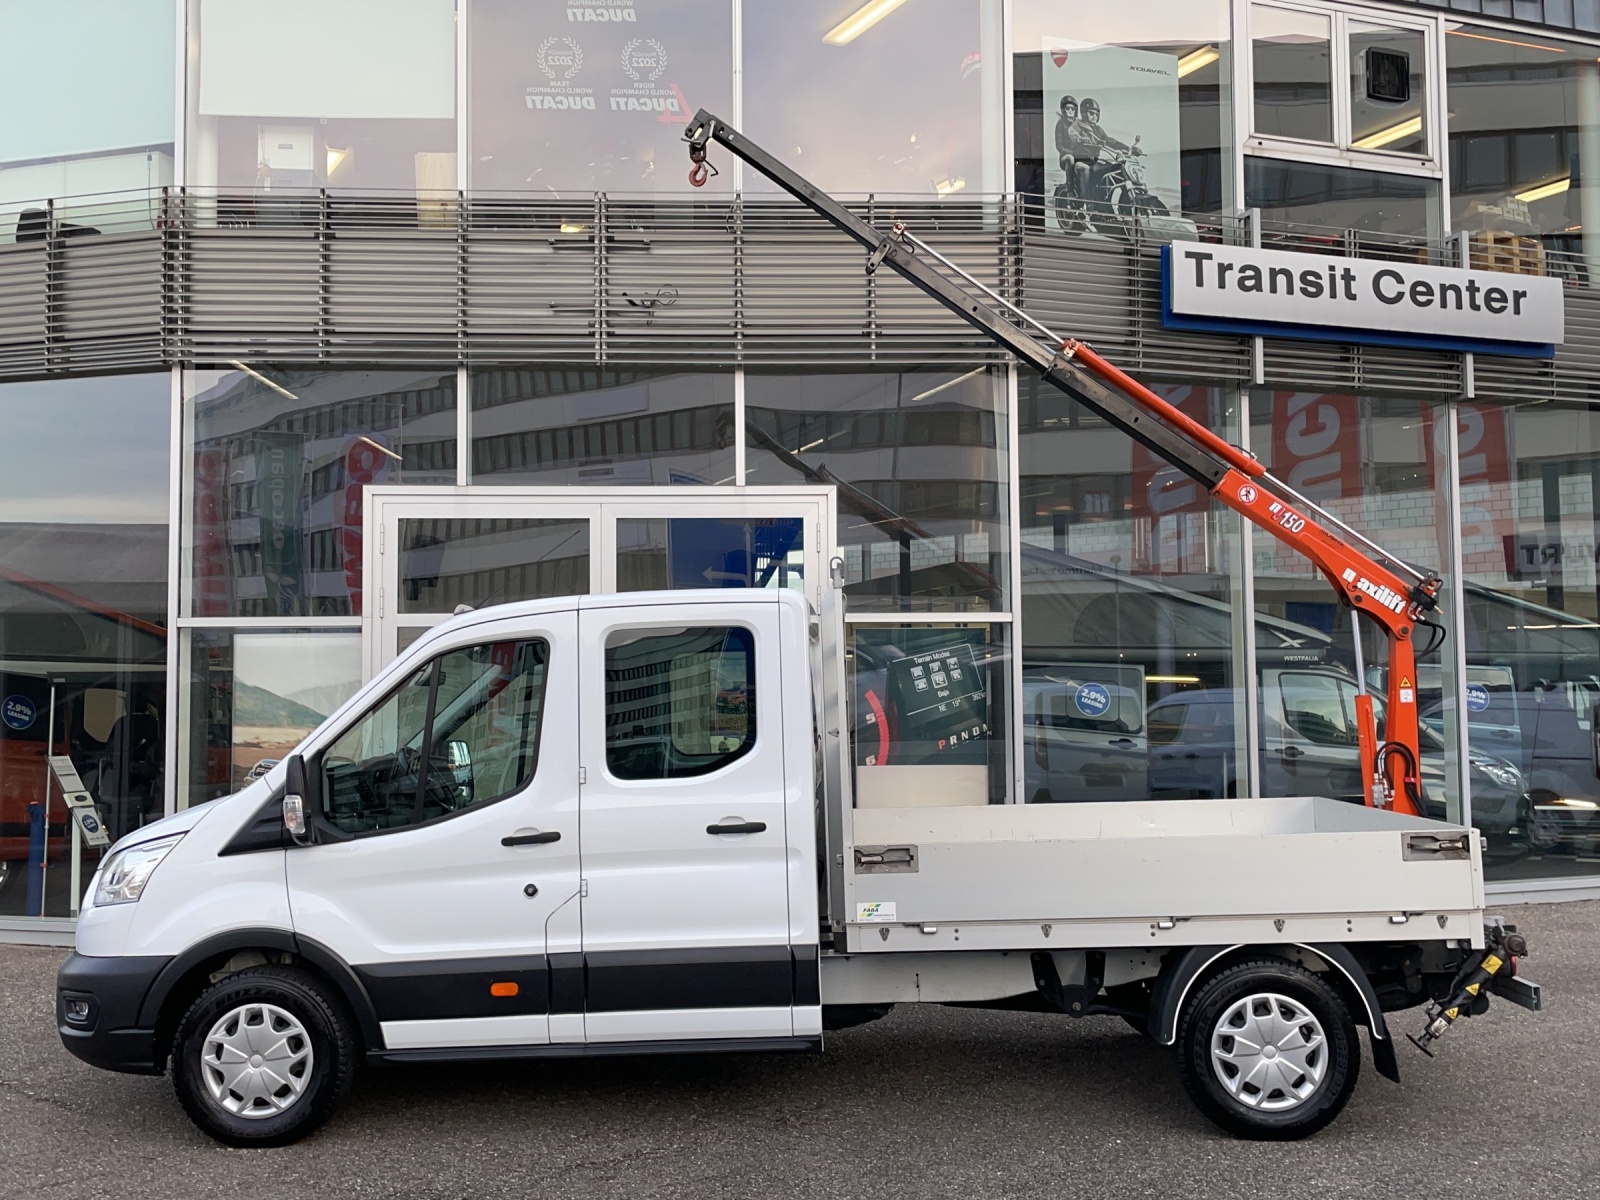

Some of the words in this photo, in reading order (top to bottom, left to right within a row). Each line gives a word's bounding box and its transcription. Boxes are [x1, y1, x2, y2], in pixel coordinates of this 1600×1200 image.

[1128, 65, 1172, 76] XDIAVEL
[1184, 251, 1357, 301] Transit
[1371, 269, 1527, 315] Center
[913, 655, 933, 664] Terrain
[932, 651, 950, 660] Modes
[1081, 688, 1106, 704] 2.9%
[1081, 697, 1104, 709] LEASING
[7, 701, 32, 716] 2.9%
[7, 709, 31, 721] LEASING
[938, 739, 946, 750] P
[950, 735, 958, 745] R
[961, 730, 969, 740] N
[972, 726, 980, 736] D
